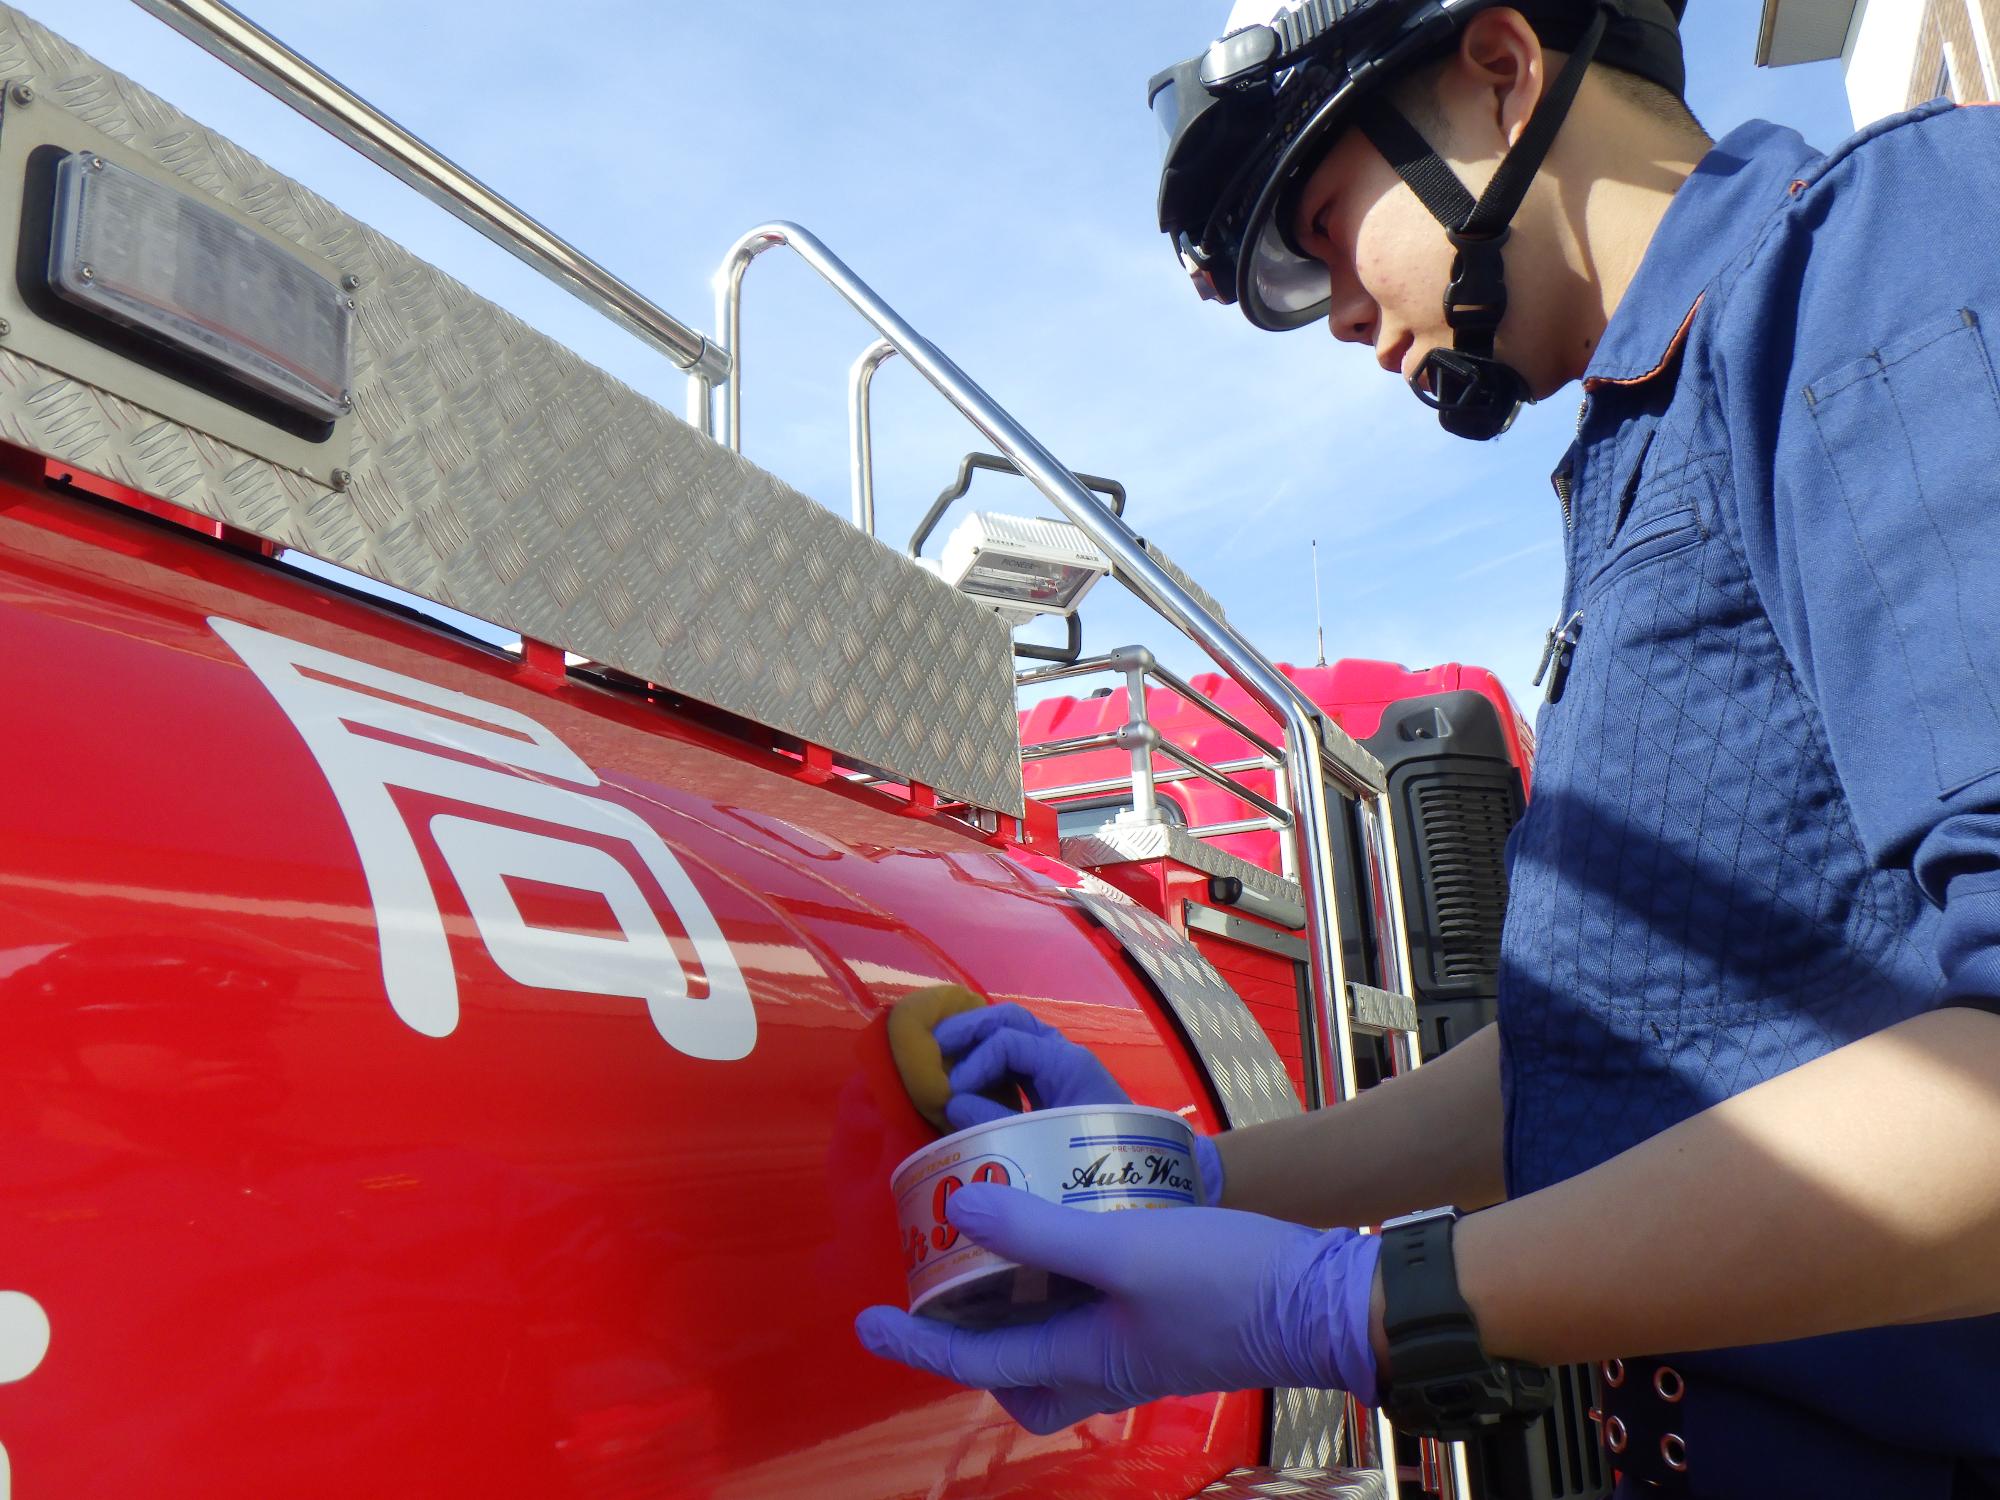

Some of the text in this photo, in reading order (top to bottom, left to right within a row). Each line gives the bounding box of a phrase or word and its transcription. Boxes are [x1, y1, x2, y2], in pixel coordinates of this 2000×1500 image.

[207, 615, 758, 1061] 局
[1062, 1153, 1193, 1191] Auto Wax
